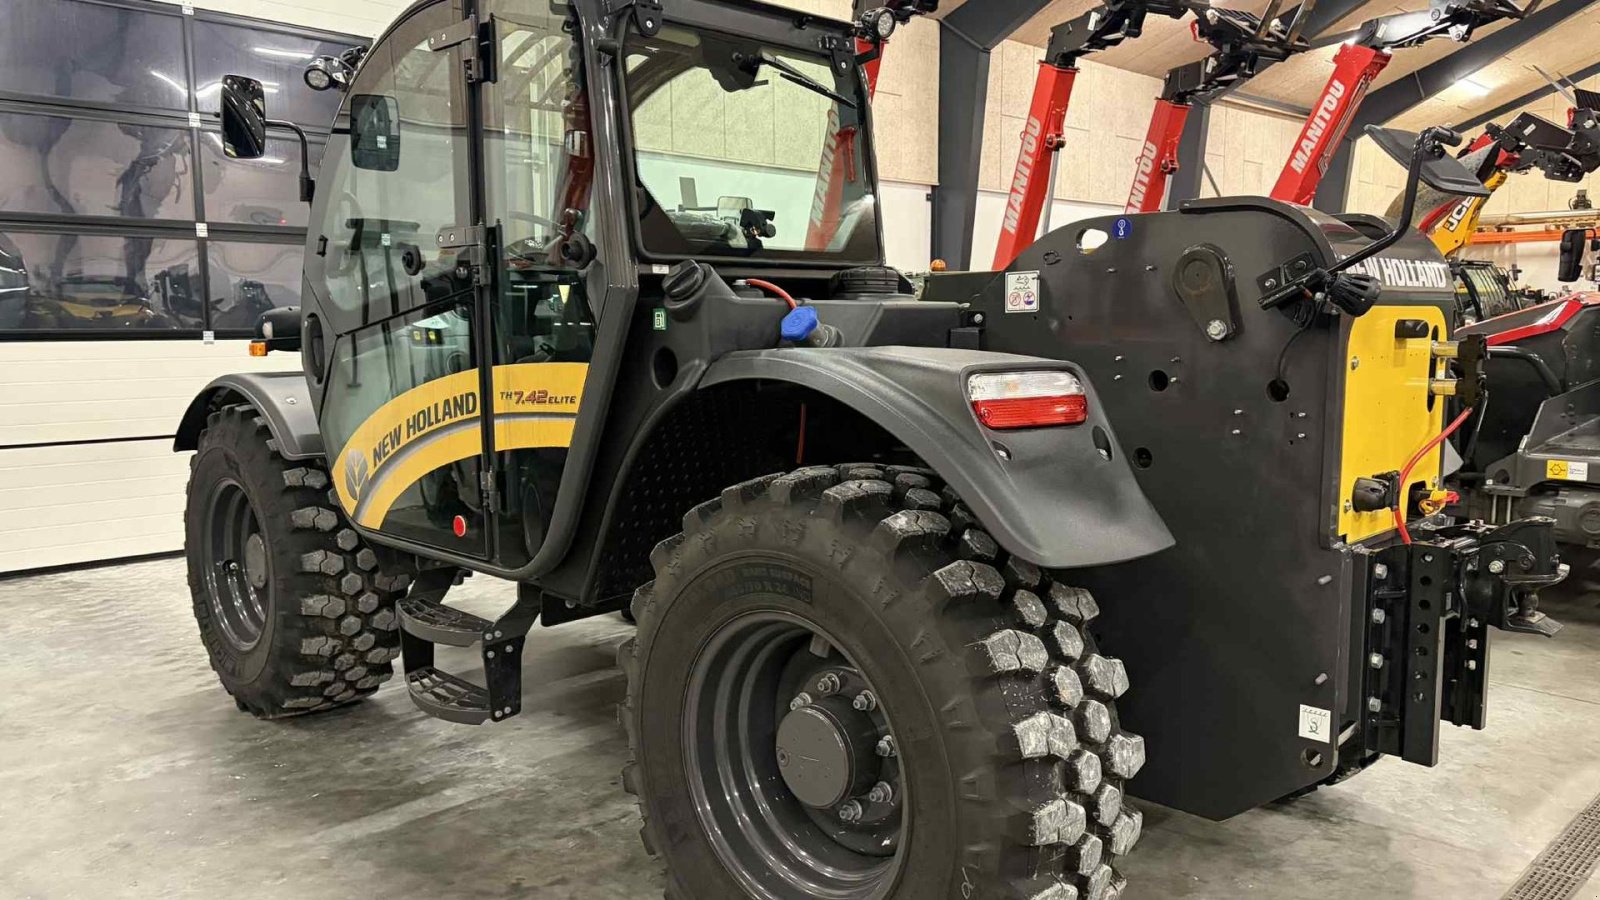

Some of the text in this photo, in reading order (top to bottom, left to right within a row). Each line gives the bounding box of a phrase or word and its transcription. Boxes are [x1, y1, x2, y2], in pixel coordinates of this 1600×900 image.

[1289, 79, 1345, 174] MANITOU
[1004, 116, 1041, 234] MANITOU
[1380, 257, 1446, 288] HOLLAND
[372, 391, 477, 467] NEW HOLLAND
[500, 390, 576, 404] TH 7.42 ELITE
